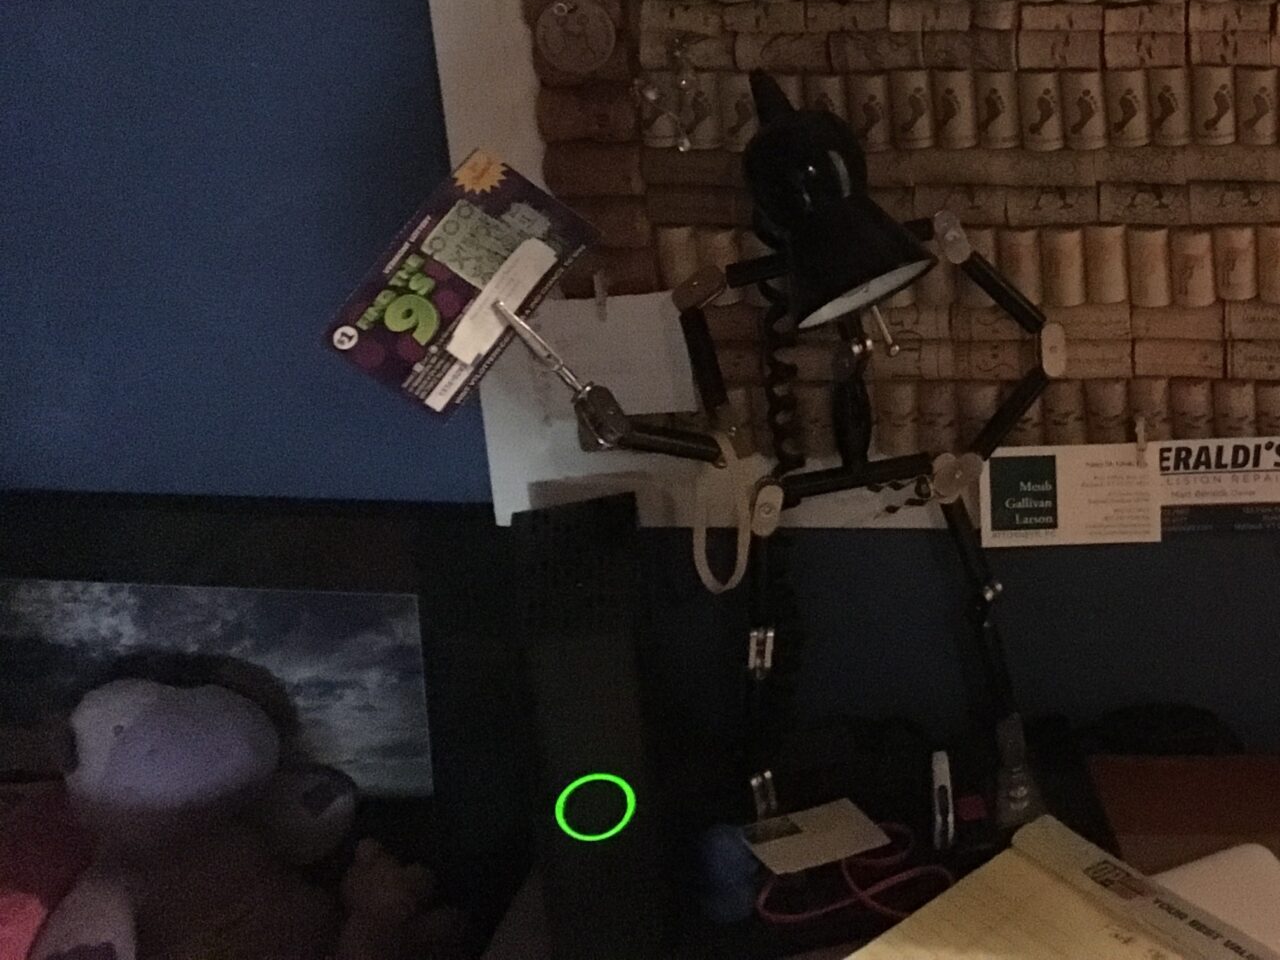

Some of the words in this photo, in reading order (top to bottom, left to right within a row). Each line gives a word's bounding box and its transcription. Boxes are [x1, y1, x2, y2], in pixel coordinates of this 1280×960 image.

[1161, 475, 1223, 487] LISION
[1004, 496, 1054, 510] Gallivan
[1015, 513, 1054, 526] Larson
